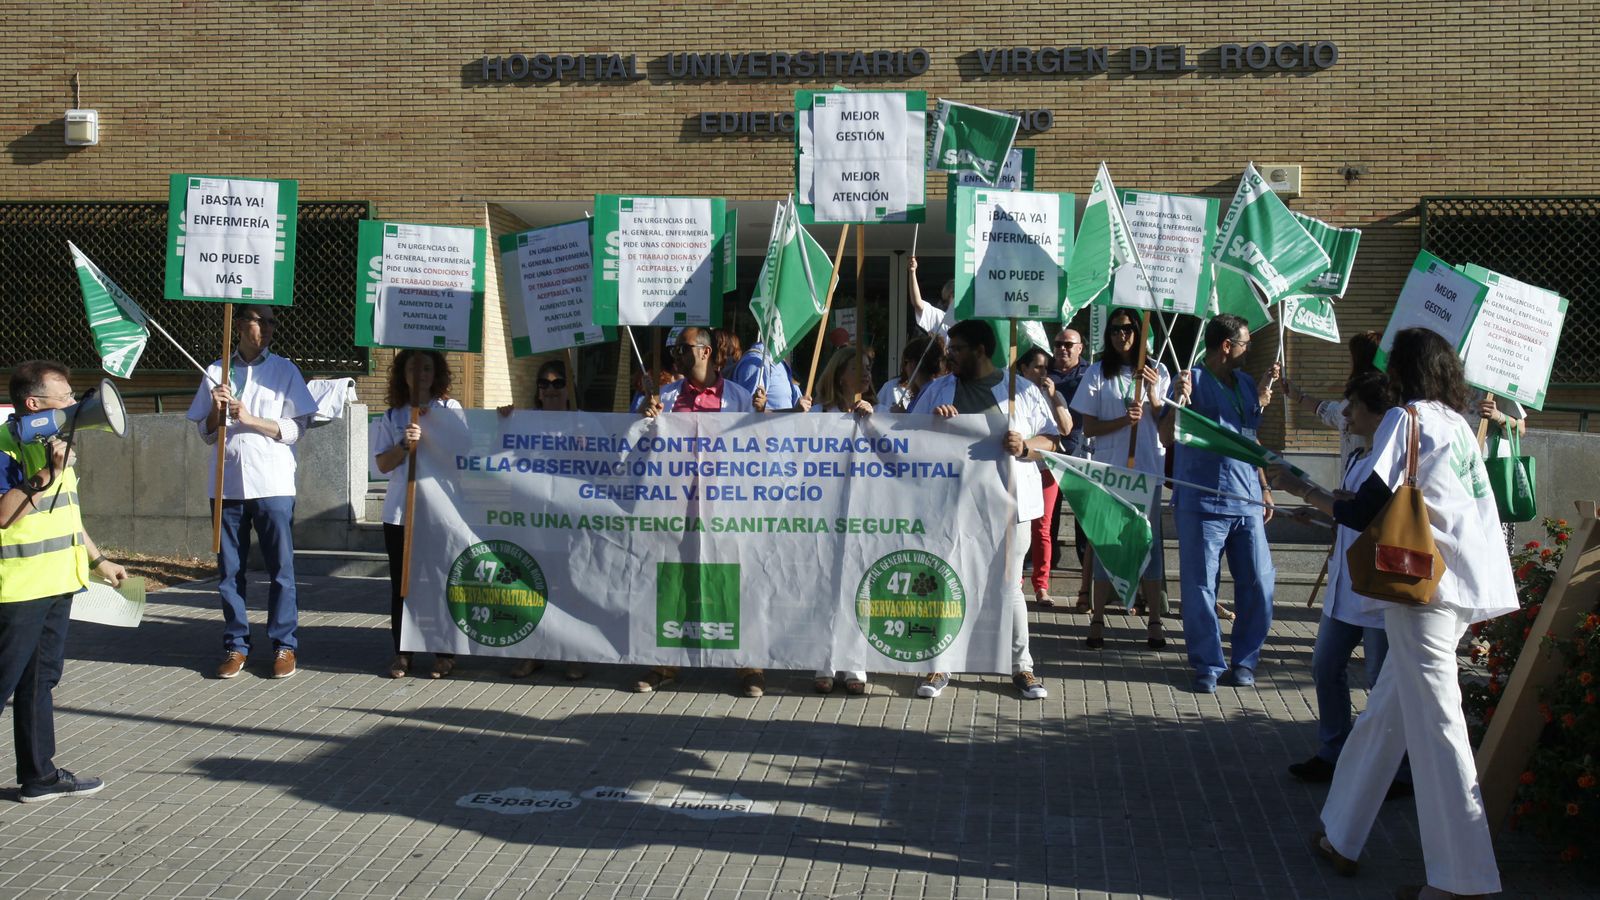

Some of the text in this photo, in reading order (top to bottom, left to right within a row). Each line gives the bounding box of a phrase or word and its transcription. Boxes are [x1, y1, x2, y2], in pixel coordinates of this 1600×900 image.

[482, 40, 1339, 80] HOSPITAL UNIVERSITARIO VIRGEN DEL ROCIO
[701, 111, 795, 134] EDIFIC
[841, 111, 879, 120] MEJOR
[836, 129, 884, 141] GESTIÓN
[842, 172, 880, 181] MEJOR
[201, 195, 264, 207] ¡BASTA YA!
[833, 190, 888, 202] ATENCIÓN
[194, 215, 270, 228] ENFERMERÍA
[989, 210, 1047, 223] ¡BASTA YA!
[983, 232, 1051, 245] ENFERMERÍA
[409, 244, 446, 252] URGENCIAS
[200, 253, 260, 264] NO PUEDE
[1229, 235, 1290, 297] SATSE
[216, 272, 242, 284] MÁS
[423, 268, 468, 276] CONDICIONES
[989, 270, 1044, 280] NO PUEDE
[1005, 290, 1029, 301] MÁS
[1434, 283, 1457, 302] MEJOR
[1424, 300, 1452, 322] GESTIÓN
[503, 434, 909, 454] ENFERMERÍA CONTRA LA SATURACIÓN
[456, 456, 960, 478] DE LA OBSERVACIÓN URGENCIAS DEL HOSPITAL
[579, 482, 822, 501] GENERAL V. DEL ROCÍO
[487, 510, 926, 534] POR UNA ASISTENCIA SANITARIA SEGURA
[474, 560, 497, 583] 47
[887, 571, 911, 595] 47
[501, 589, 544, 606] SATURADA
[472, 606, 490, 623] 29
[917, 600, 962, 618] SATURADA
[458, 618, 533, 644] POR TU SALUD
[662, 621, 734, 640] SATSE
[884, 620, 905, 638] 29
[869, 633, 953, 660] POR TU SALUD
[470, 794, 574, 809] Espacio
